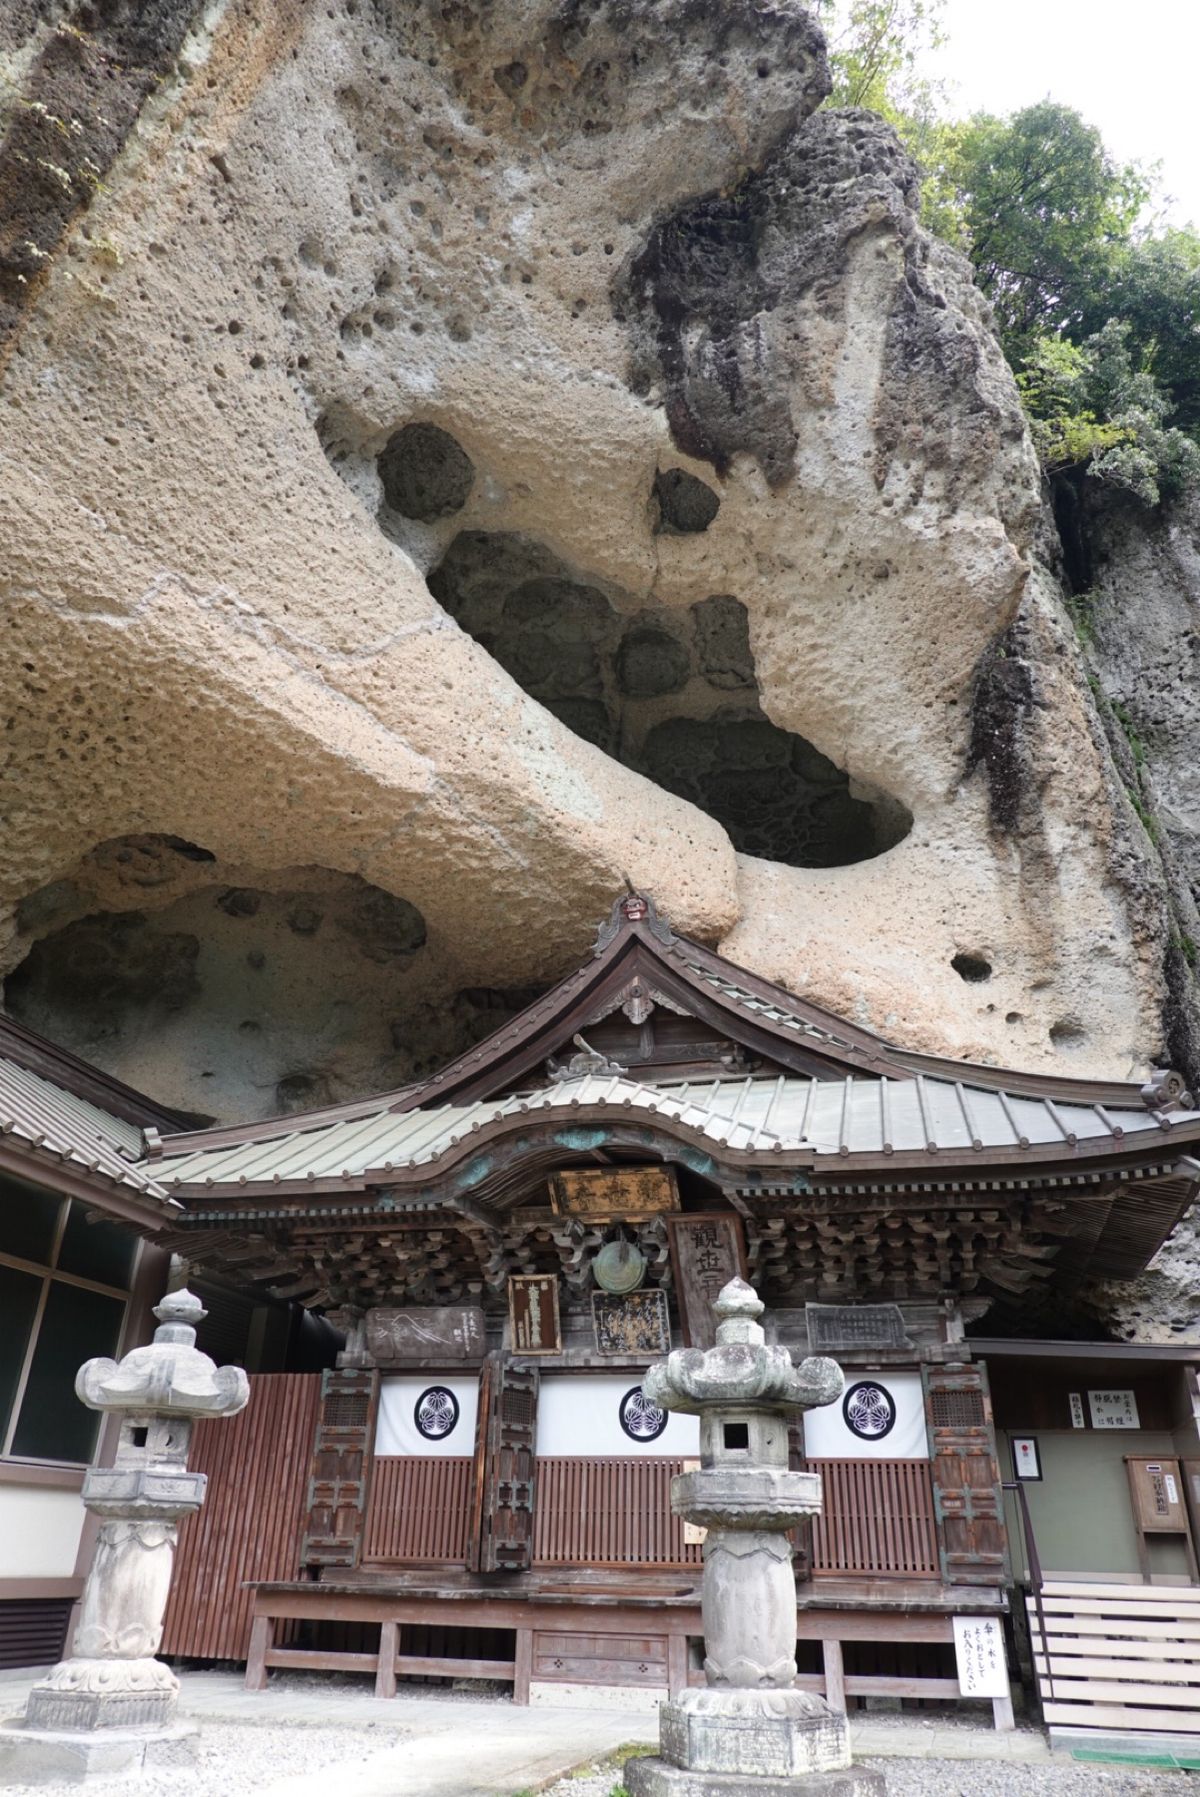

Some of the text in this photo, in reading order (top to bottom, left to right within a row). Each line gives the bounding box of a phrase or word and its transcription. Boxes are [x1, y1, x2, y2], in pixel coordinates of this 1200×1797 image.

[963, 1629, 976, 1690] お入りください
[975, 1627, 985, 1678] よくおとして
[984, 1622, 996, 1669] 傘の水を
